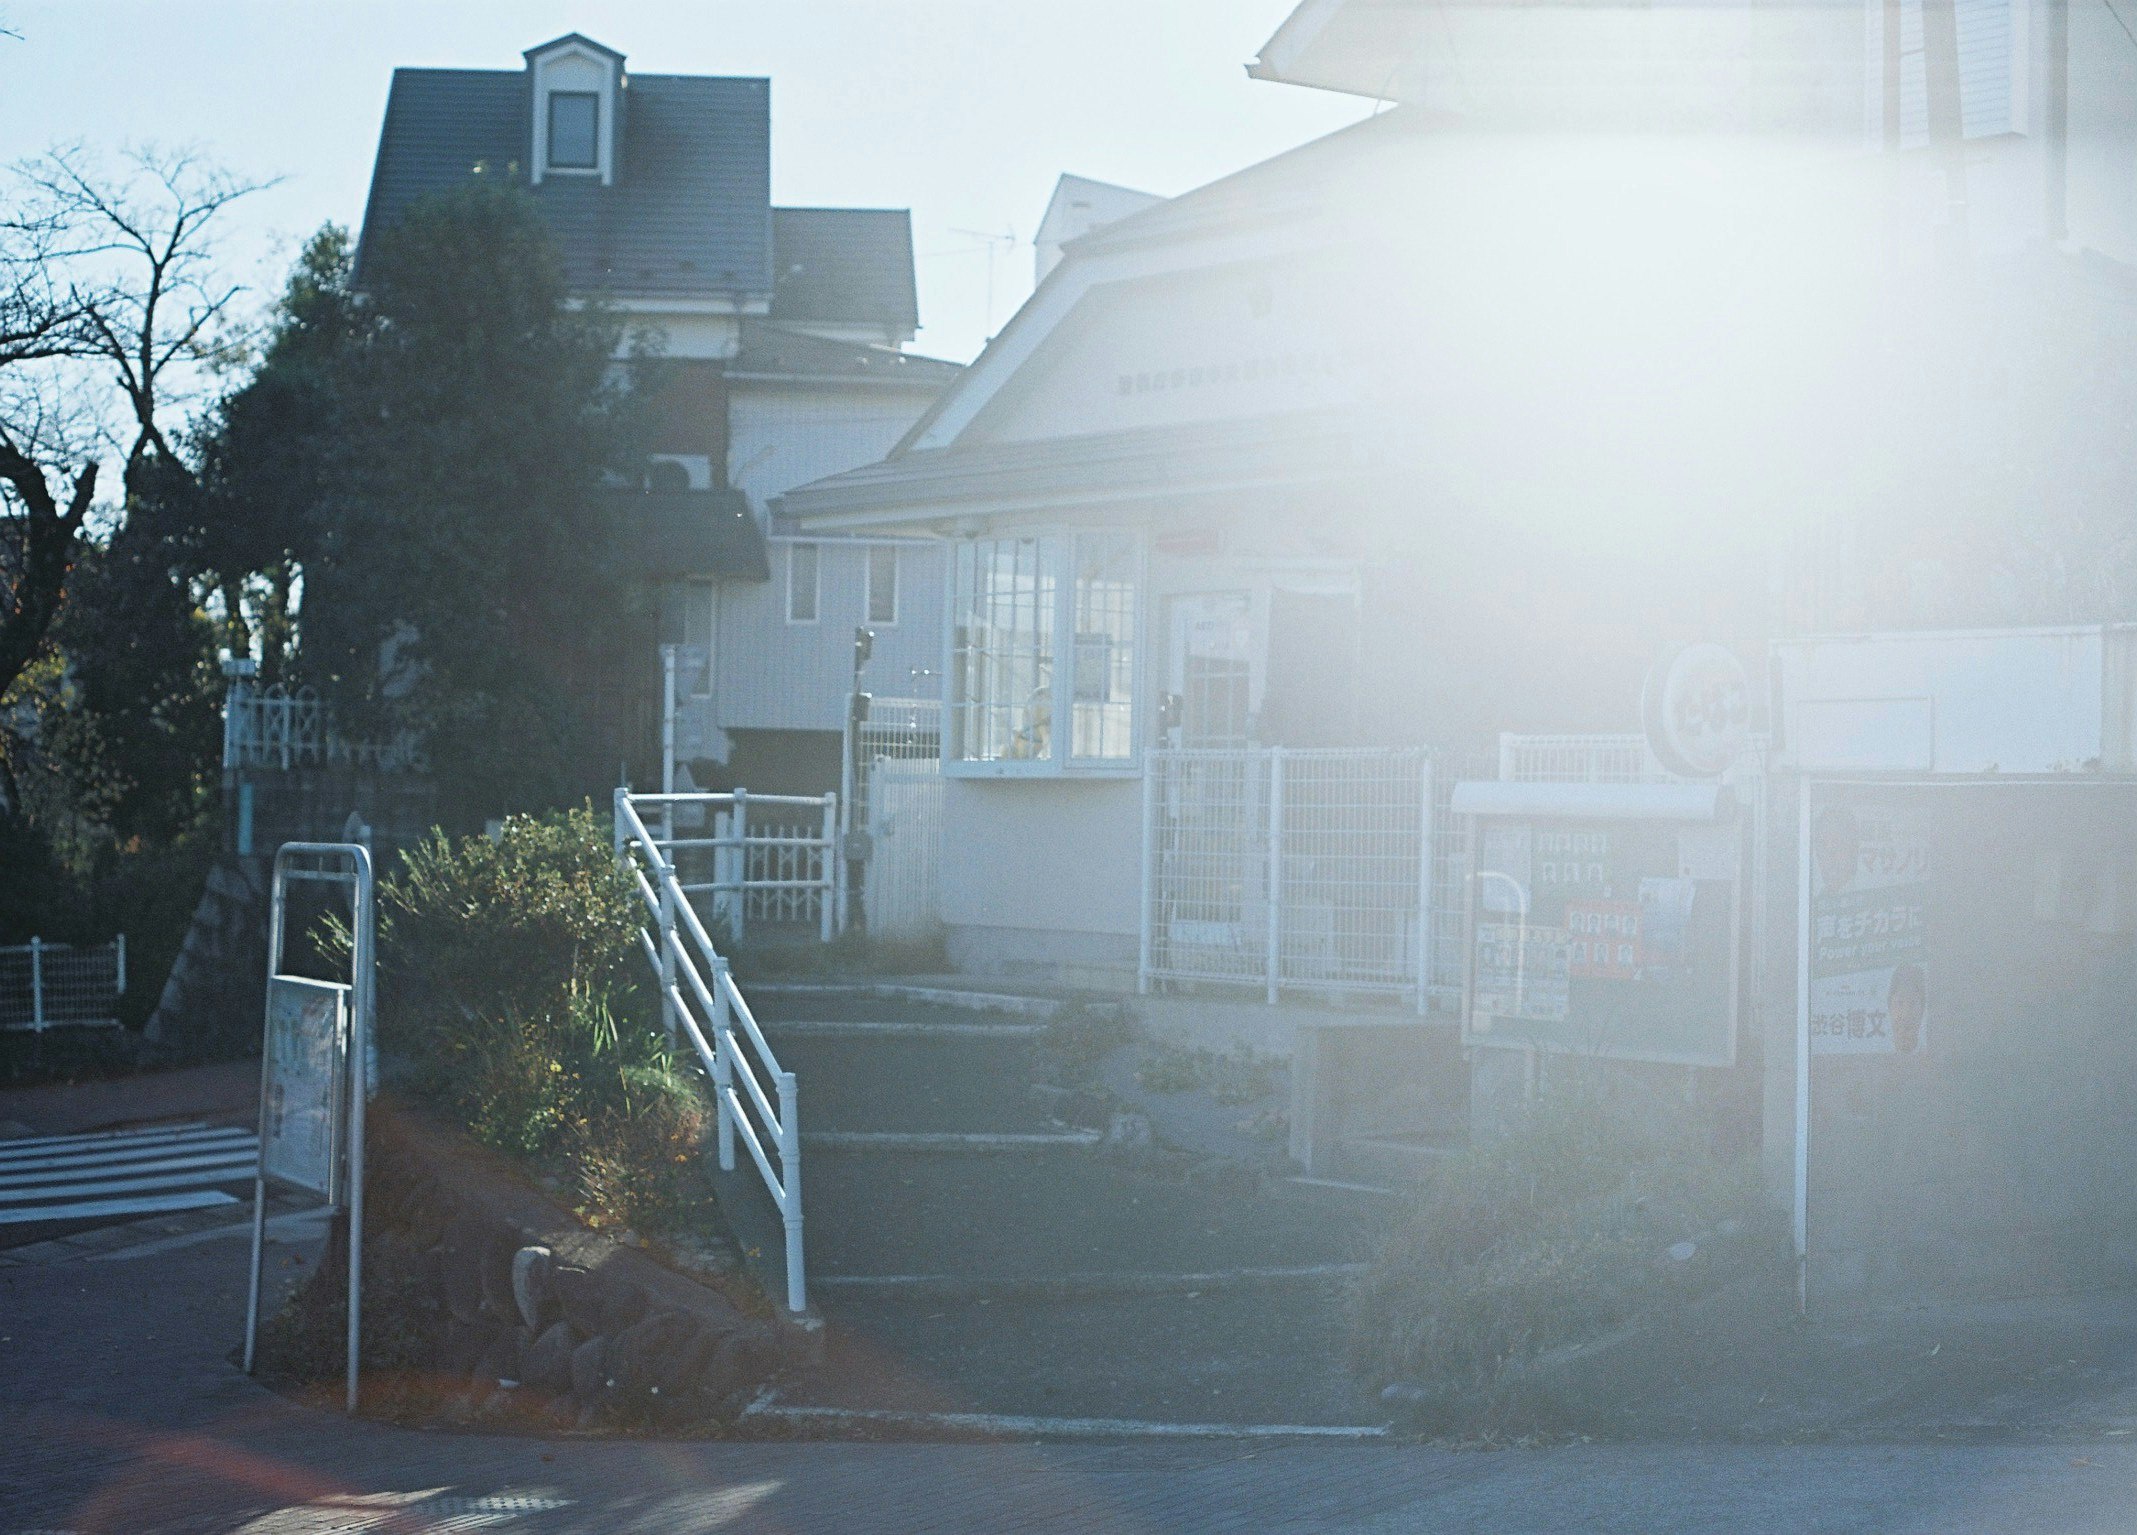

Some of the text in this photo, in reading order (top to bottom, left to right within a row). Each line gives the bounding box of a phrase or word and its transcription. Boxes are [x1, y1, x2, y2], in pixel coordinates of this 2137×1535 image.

[1816, 905, 1923, 944] 声をチカラに
[1818, 945, 1858, 961] Power
